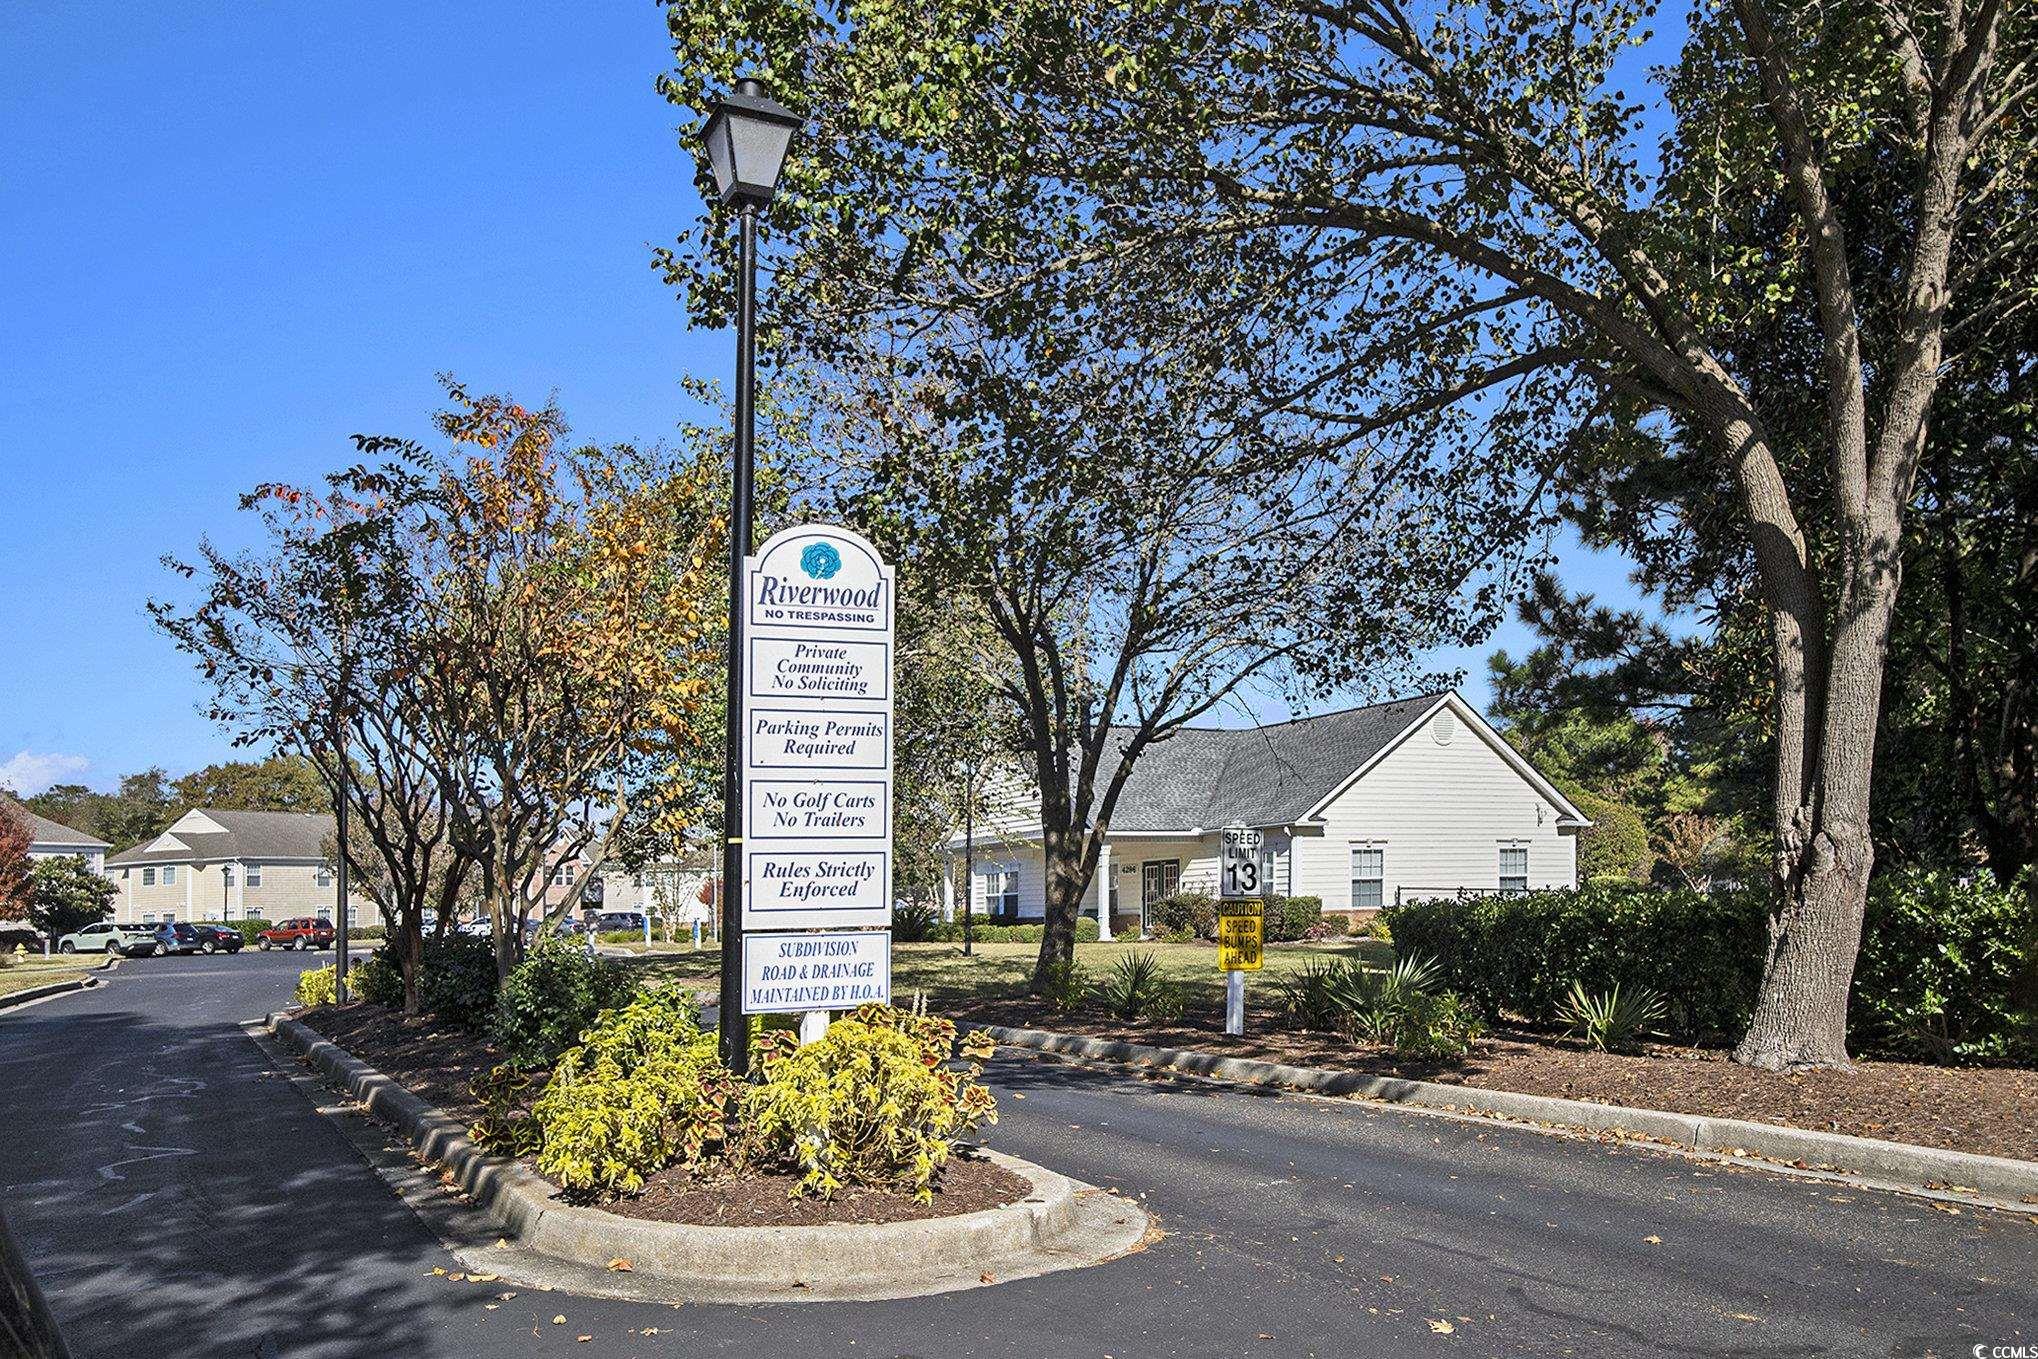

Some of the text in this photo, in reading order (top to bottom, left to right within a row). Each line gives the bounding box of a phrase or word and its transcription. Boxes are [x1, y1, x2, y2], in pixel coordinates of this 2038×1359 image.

[758, 576, 881, 608] Riverwood
[765, 610, 875, 623] NO TRESPASSING
[795, 644, 847, 660] Private
[777, 659, 862, 677] Community
[772, 675, 868, 695] No Soliciting
[756, 719, 883, 739] Parking Permits
[784, 739, 856, 758] Required
[763, 792, 875, 812] No Golf Carts
[773, 812, 866, 827] No Trailers
[1225, 833, 1261, 845] SPEED
[1228, 848, 1255, 859] LIMIT
[762, 861, 875, 881] Rules Strictly
[1227, 863, 1257, 892] 13
[779, 880, 859, 901] Enforced
[1222, 902, 1261, 916] CAUTION
[1226, 920, 1256, 933] SPEED
[778, 940, 859, 958] SUBDIVISION
[1225, 935, 1258, 949] BUMPS
[1225, 951, 1256, 964] AHEAD
[762, 962, 874, 981] ROAD & DRAINAGE
[750, 984, 884, 1004] MAINTAINED BY H.O.A.
